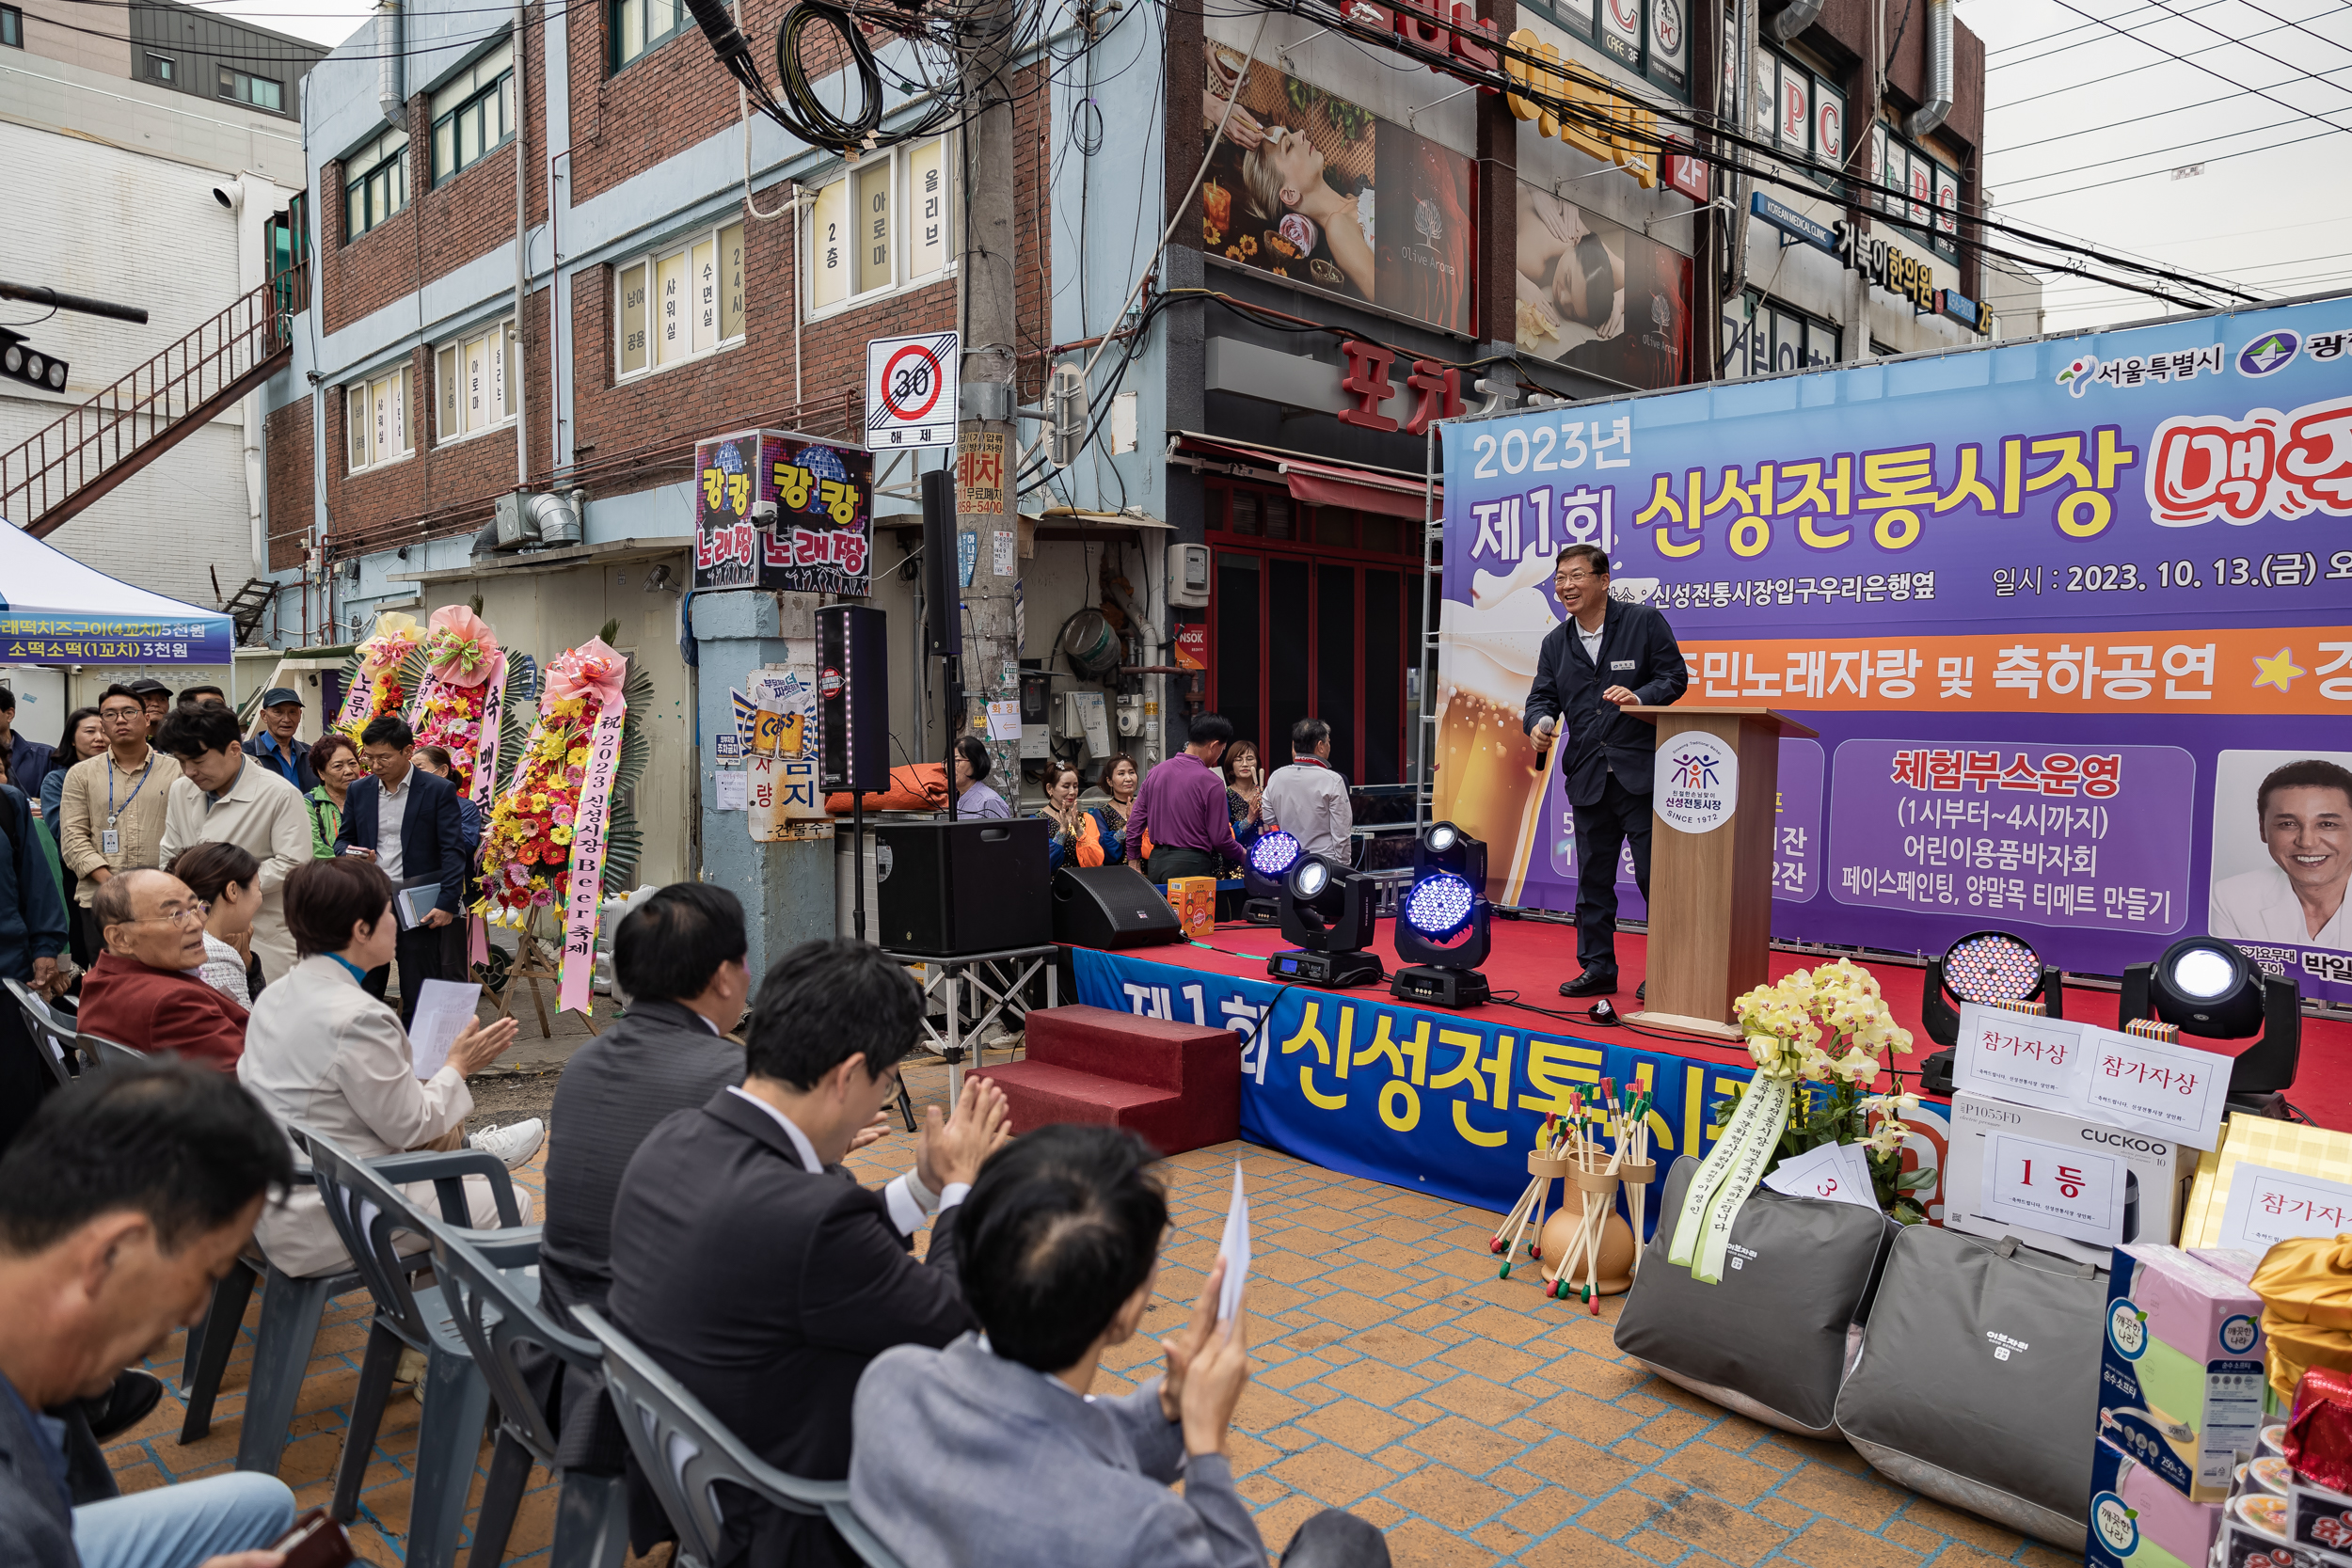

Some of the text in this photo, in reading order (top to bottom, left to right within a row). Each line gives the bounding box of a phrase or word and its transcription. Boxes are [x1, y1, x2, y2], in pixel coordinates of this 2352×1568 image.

[1606, 34, 1639, 63] CAFE 3F
[1660, 20, 1676, 46] PC
[1784, 75, 1840, 159] P C
[1677, 151, 1703, 188] 2F
[925, 167, 939, 247] 올리브
[1912, 166, 1955, 234] P C
[872, 191, 886, 266] 아로마
[1767, 200, 1827, 243] KOREAN MEDICAL CLINIC
[826, 222, 839, 270] 2층
[1402, 245, 1454, 276] Olive Aroma
[1834, 219, 1932, 309] 거북이한의원
[627, 286, 645, 309] 남여
[702, 262, 713, 328] 수면실
[732, 247, 743, 314] 24시
[665, 277, 677, 341] 샤워실
[1947, 291, 1976, 322] 456-5030
[1979, 302, 1994, 335] 2F
[627, 328, 646, 353] 공용
[1642, 334, 1678, 356] Olive Aroma
[895, 368, 929, 398] 30
[2098, 346, 2220, 385] 서울특별시
[1472, 416, 1631, 479] 2023년
[703, 468, 752, 516] 캉캉
[773, 462, 859, 525] 캉캉
[1470, 487, 1613, 562] 제1회
[1635, 429, 2134, 558] 신성전통시장
[698, 525, 753, 567] 노래짱
[765, 531, 866, 574] 노래짱
[1651, 571, 1936, 610] 신성전통시장입구우리은행옆
[1993, 566, 2042, 596] 일시
[2066, 565, 2147, 593] 2023.
[2157, 561, 2202, 589] 10.
[143, 642, 188, 658] 3천원
[1179, 632, 1203, 643] NSOK
[785, 672, 797, 686] 더
[1937, 656, 1974, 700] 및
[1993, 642, 2217, 701] 축하공연
[599, 715, 622, 731] 祝
[592, 734, 615, 789] 2023
[717, 743, 739, 754] 주차금지
[1892, 749, 2122, 799] 체험부스운영
[1665, 797, 1722, 811] 신성전통시장
[1666, 810, 1718, 824] SINCE 1972
[1898, 797, 2109, 840] (1시부터~4시까지)
[577, 794, 605, 854] 신성시장
[1904, 834, 2097, 878] 어린이용품바자회
[576, 857, 596, 920] Beer
[1842, 865, 2171, 925] 페이스페인팅, 양말목 티메트 만들기
[564, 924, 594, 957] 축제
[1981, 1030, 2069, 1066] 참가자상
[2102, 1054, 2200, 1096] 참가자상
[1754, 1086, 1787, 1148] 신성전통시장
[1965, 1102, 2022, 1126] P1055FD
[2081, 1129, 2168, 1156] CUCKOO
[2020, 1159, 2086, 1198] 1 등
[2155, 1158, 2167, 1168] 10
[2260, 1192, 2352, 1228] 참가자
[1986, 1330, 2029, 1351] 이브자리
[2115, 1313, 2141, 1338] 깨끗한
[2118, 1328, 2136, 1348] 나라
[2227, 1325, 2252, 1337] 깨끗한
[2230, 1336, 2247, 1346] 나라
[2103, 1370, 2137, 1400] 순수소프티
[2168, 1425, 2187, 1436] SOFTY
[2101, 1506, 2131, 1535] 깨끗한
[2105, 1522, 2124, 1545] 나라
